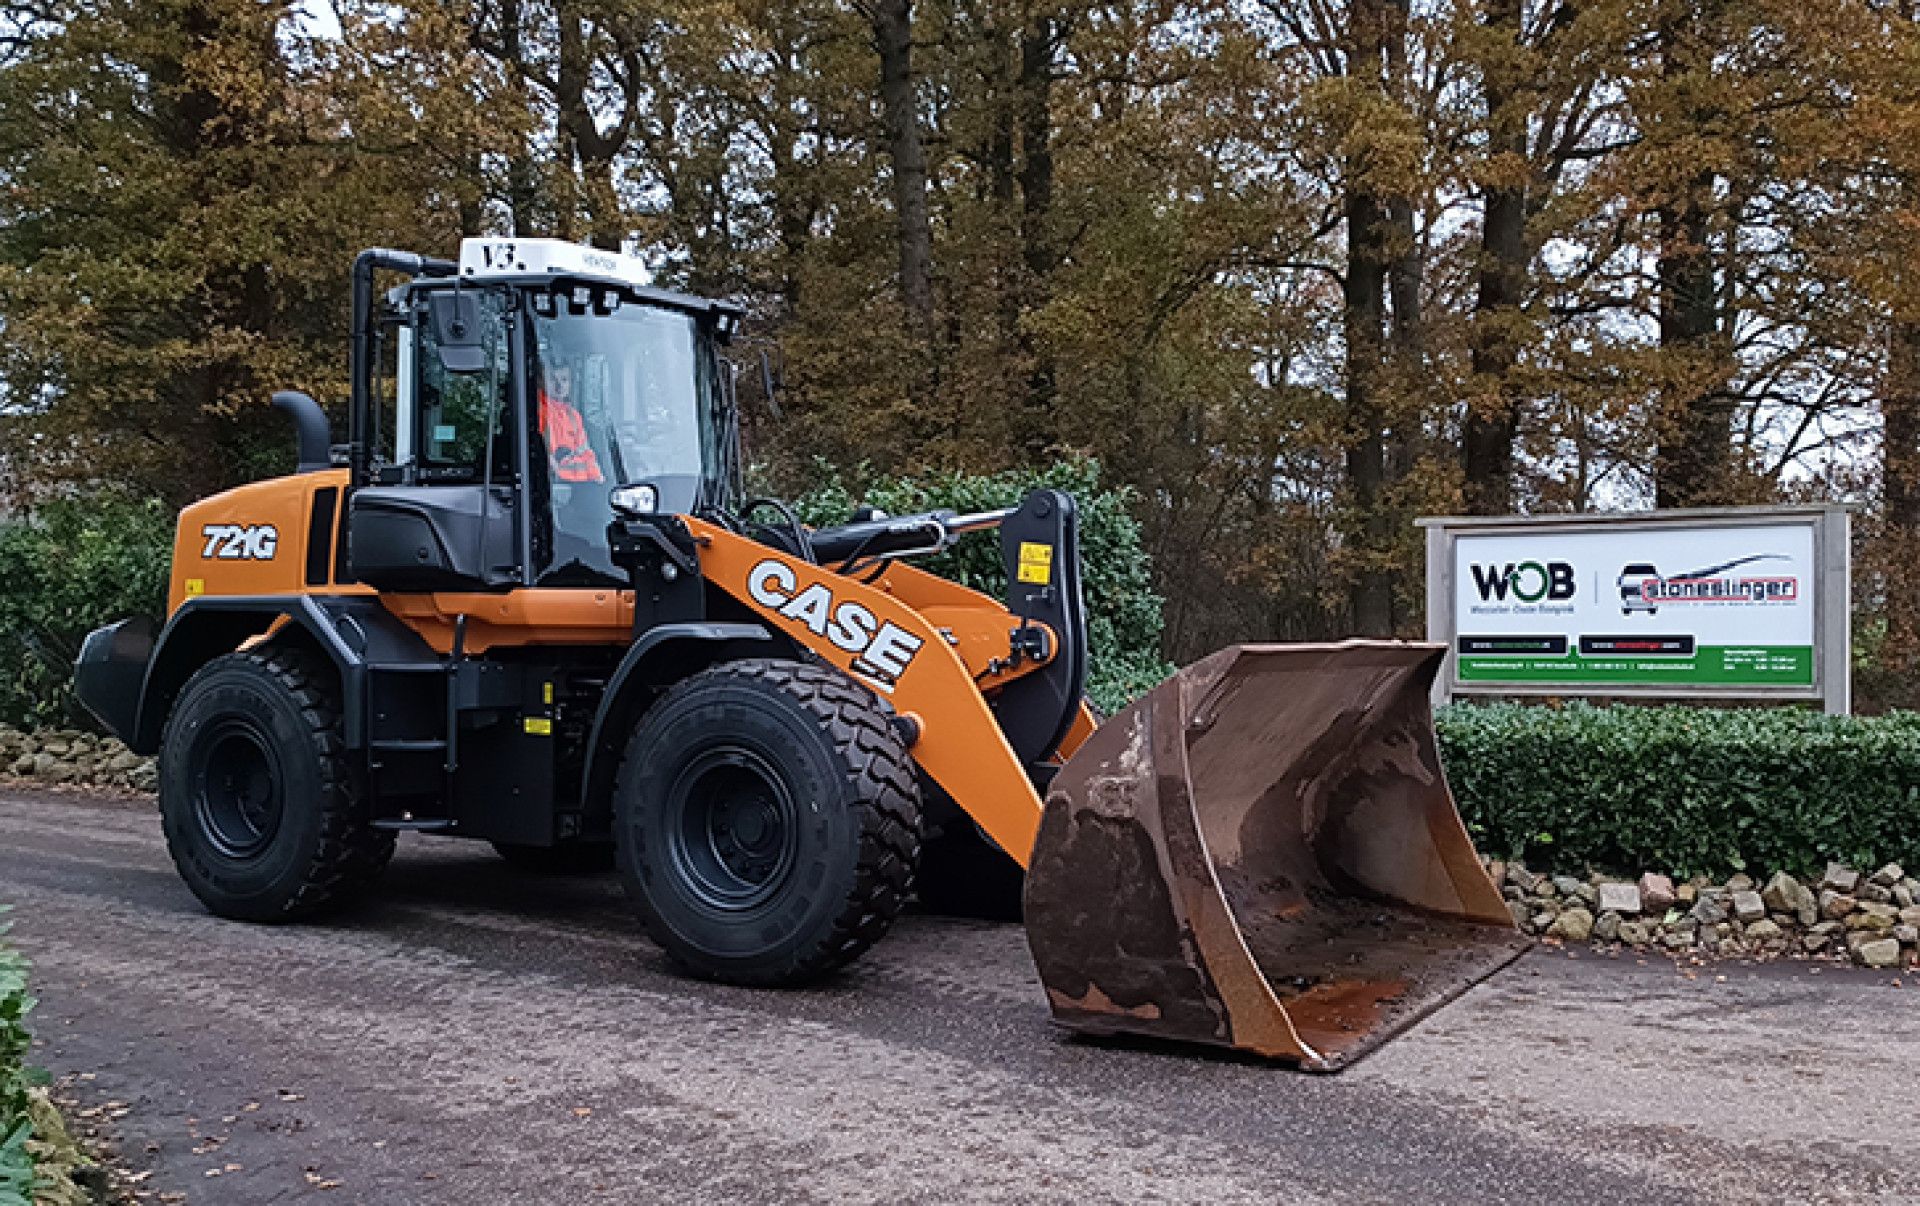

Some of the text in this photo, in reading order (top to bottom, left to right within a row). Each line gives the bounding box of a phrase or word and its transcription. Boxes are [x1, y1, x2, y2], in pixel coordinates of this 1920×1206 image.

[202, 524, 277, 559] 721G
[1470, 561, 1576, 602] WOB
[748, 558, 925, 682] CASE
